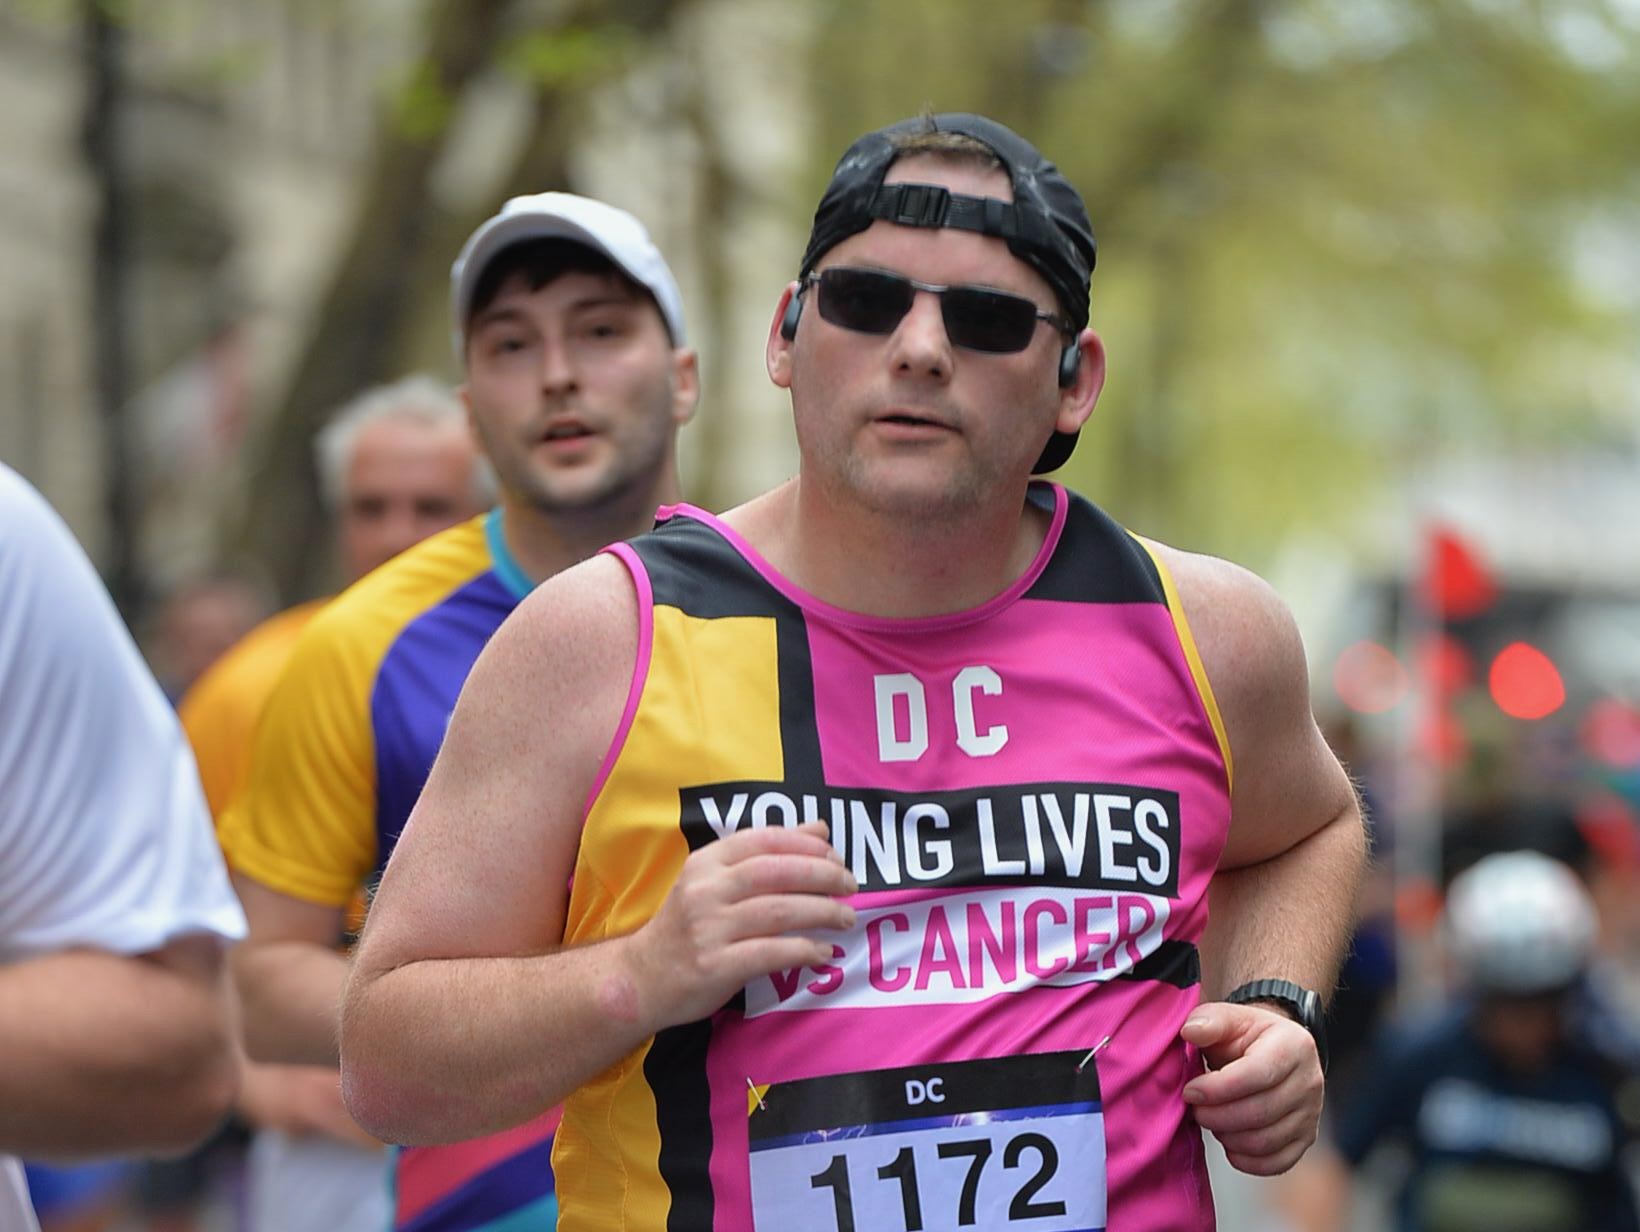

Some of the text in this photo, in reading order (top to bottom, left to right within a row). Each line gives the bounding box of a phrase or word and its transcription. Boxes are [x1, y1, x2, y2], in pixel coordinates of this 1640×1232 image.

[977, 792, 1171, 886] LIVES
[865, 895, 1156, 992] CANCER
[905, 1077, 946, 1105] DC
